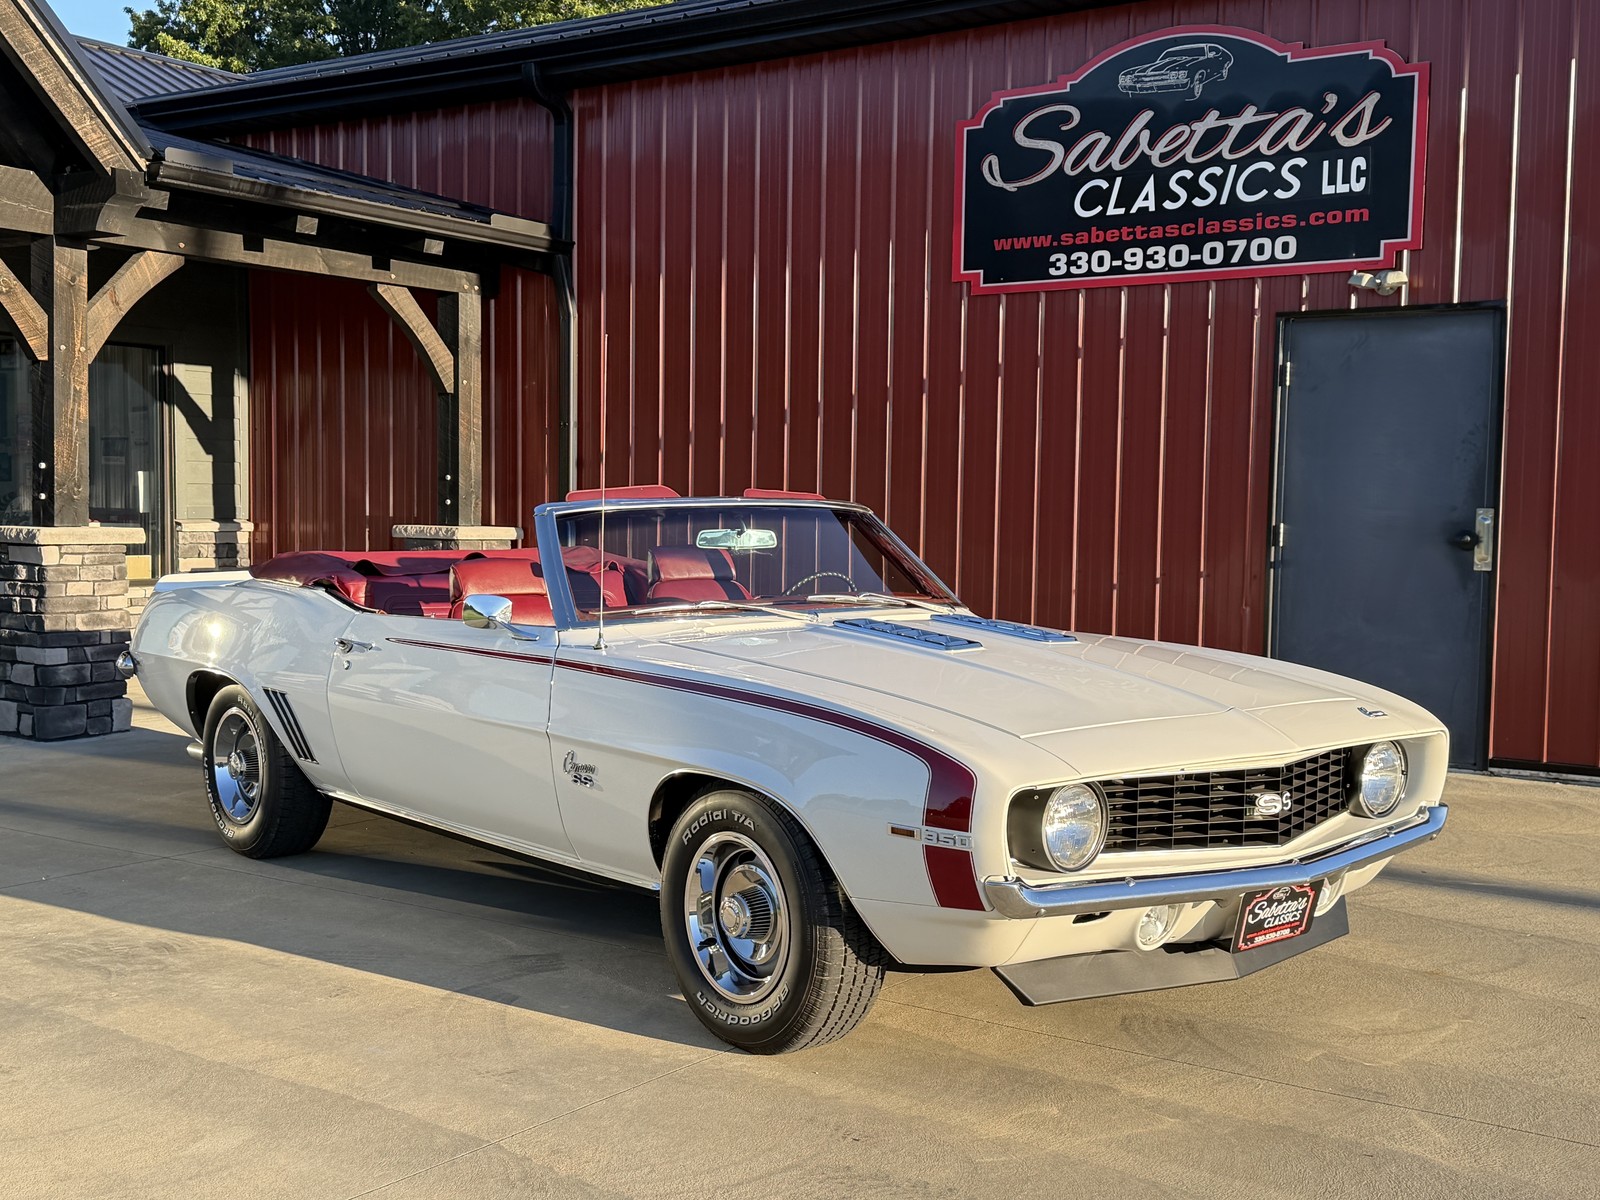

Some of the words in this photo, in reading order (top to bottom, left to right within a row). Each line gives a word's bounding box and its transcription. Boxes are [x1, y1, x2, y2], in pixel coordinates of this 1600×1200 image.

[981, 91, 1393, 192] Sabetta's
[1074, 157, 1308, 219] CLASSICS
[1321, 156, 1367, 195] LLC
[993, 207, 1370, 251] www.sabettasclassics.com
[1048, 235, 1298, 277] 330-930-0700
[682, 808, 728, 846] Radial
[731, 809, 756, 832] T/A
[923, 828, 972, 849] 350
[1247, 896, 1308, 925] Sabetta's
[1263, 910, 1303, 929] CLASSICS
[696, 982, 790, 1026] BFGoodrich
